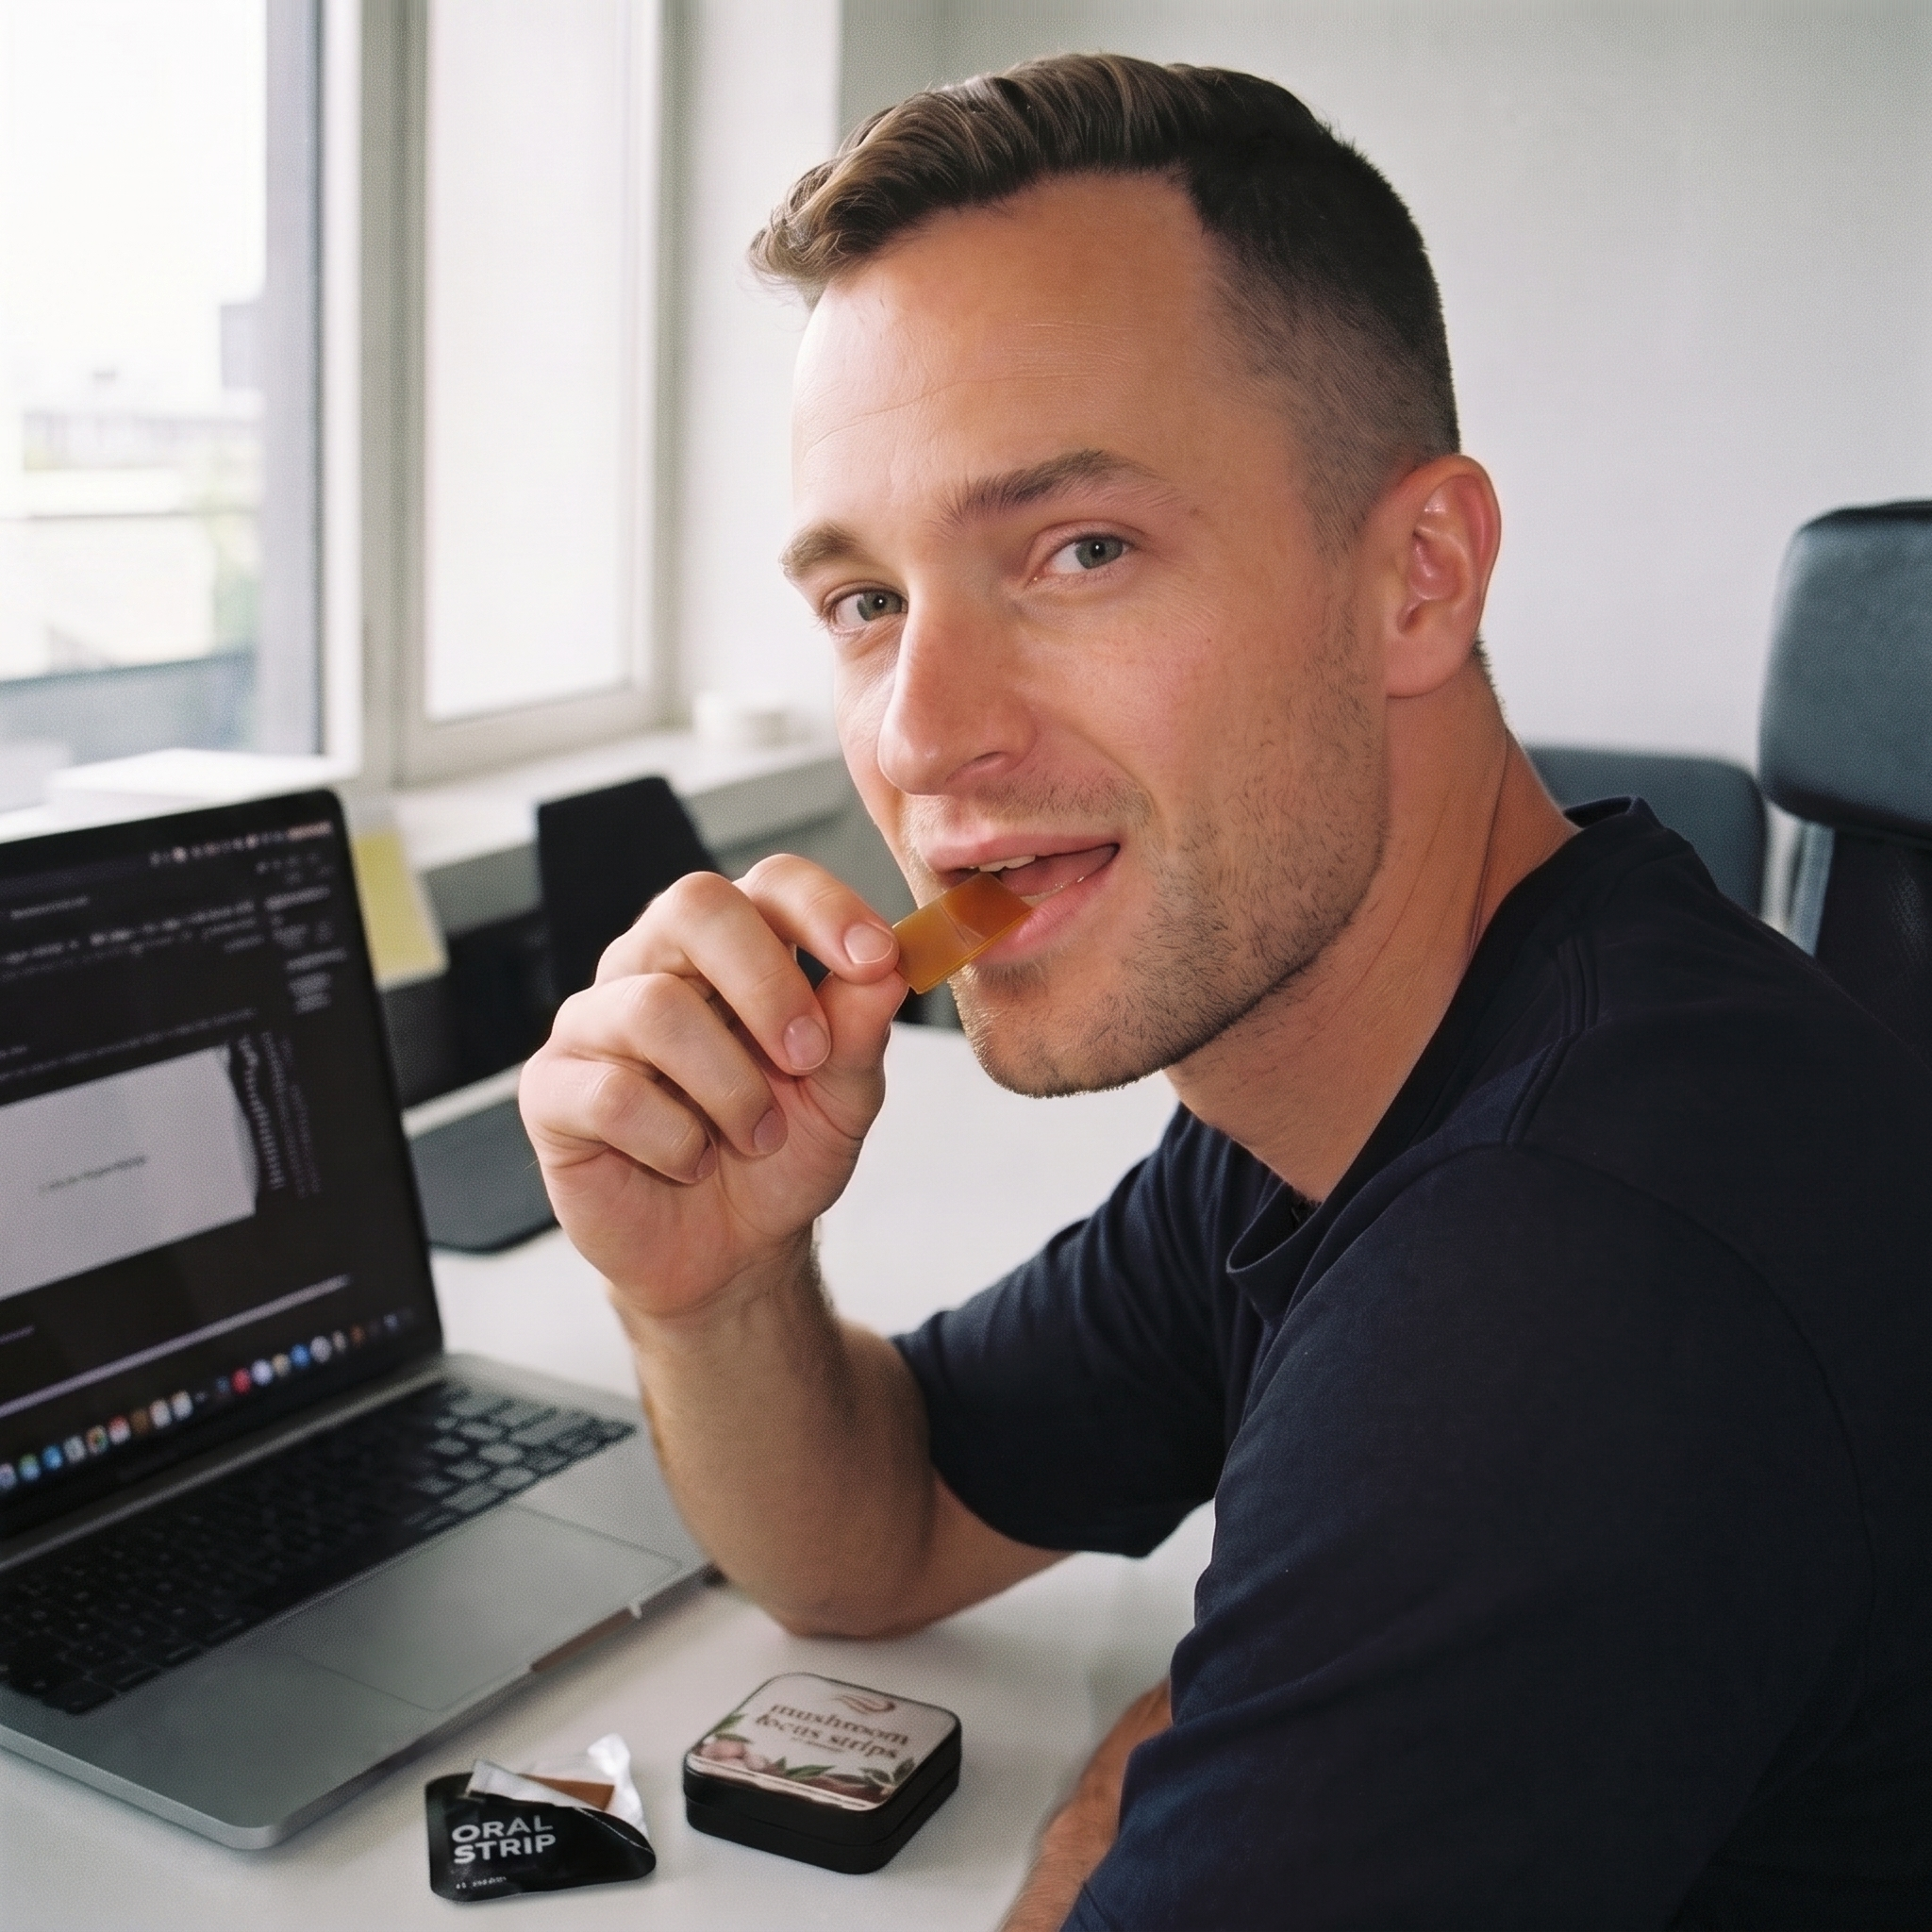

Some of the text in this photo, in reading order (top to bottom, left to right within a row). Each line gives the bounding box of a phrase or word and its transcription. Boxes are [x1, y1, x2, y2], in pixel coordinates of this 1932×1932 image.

[771, 1705, 908, 1745] mushroom
[830, 1735, 897, 1759] strips
[452, 1815, 553, 1843] ORAL
[454, 1834, 556, 1864] STRIP
